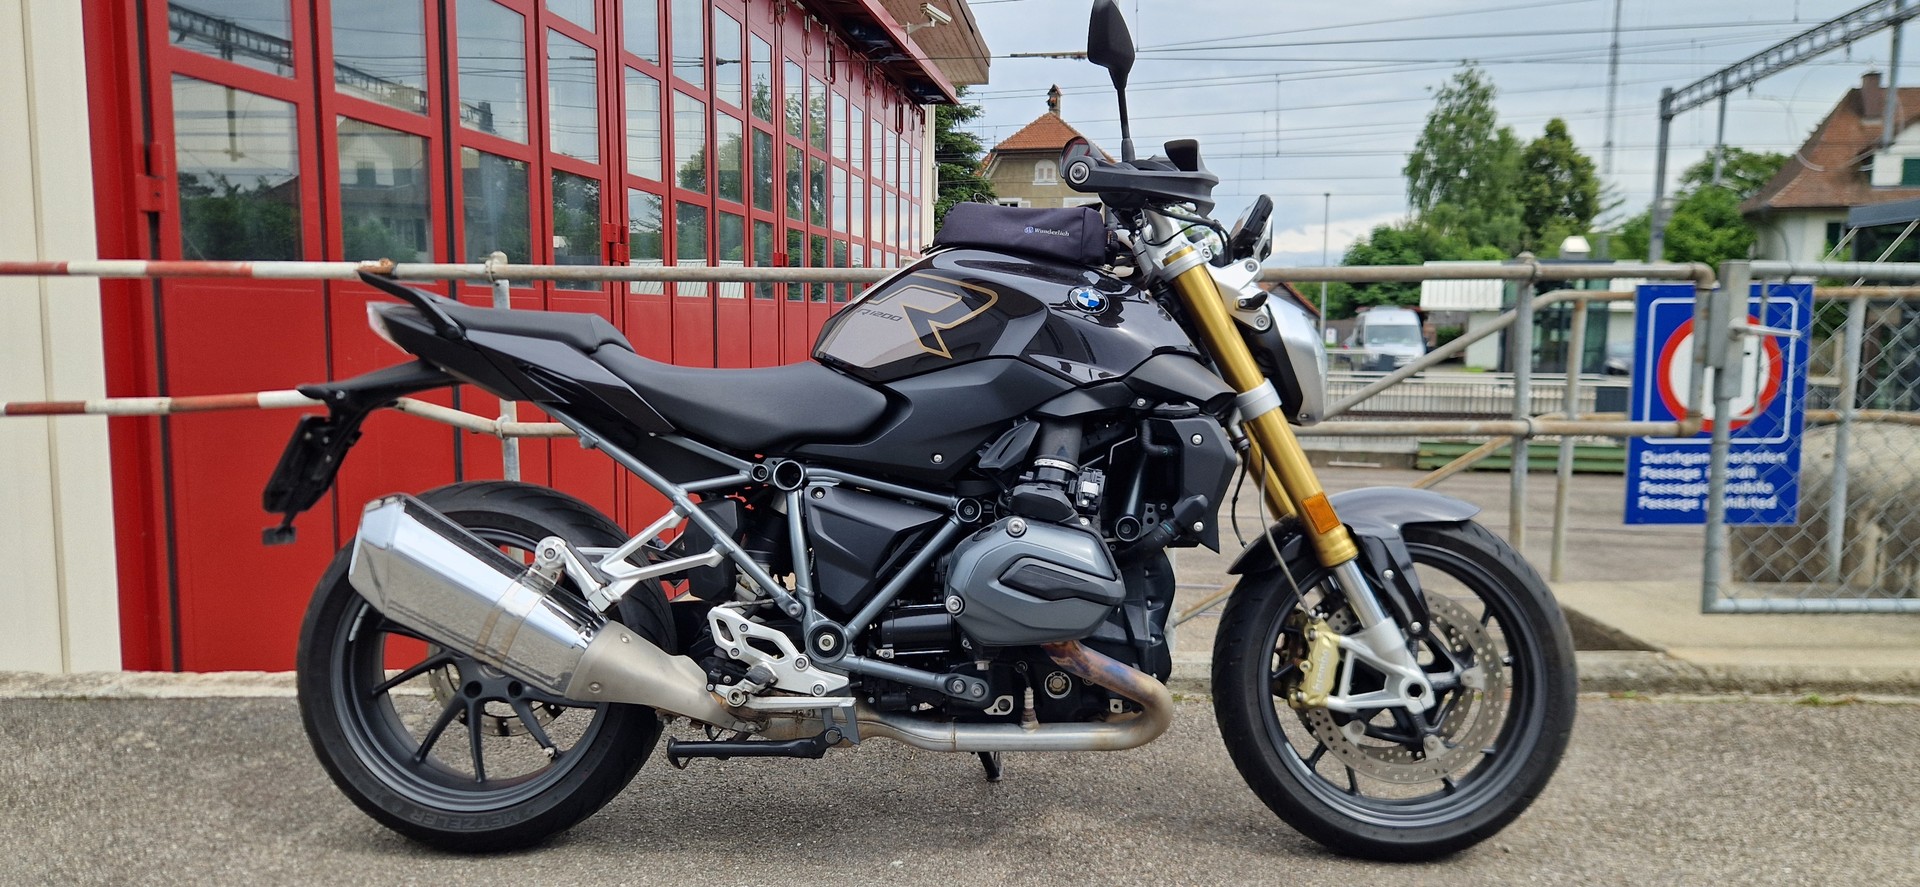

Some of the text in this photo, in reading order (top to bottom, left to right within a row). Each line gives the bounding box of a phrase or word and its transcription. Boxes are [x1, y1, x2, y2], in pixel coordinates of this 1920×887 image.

[1641, 450, 1711, 466] Durchgan
[1640, 466, 1701, 482] Passage
[1638, 496, 1700, 512] Passage
[410, 810, 518, 829] METZELER
